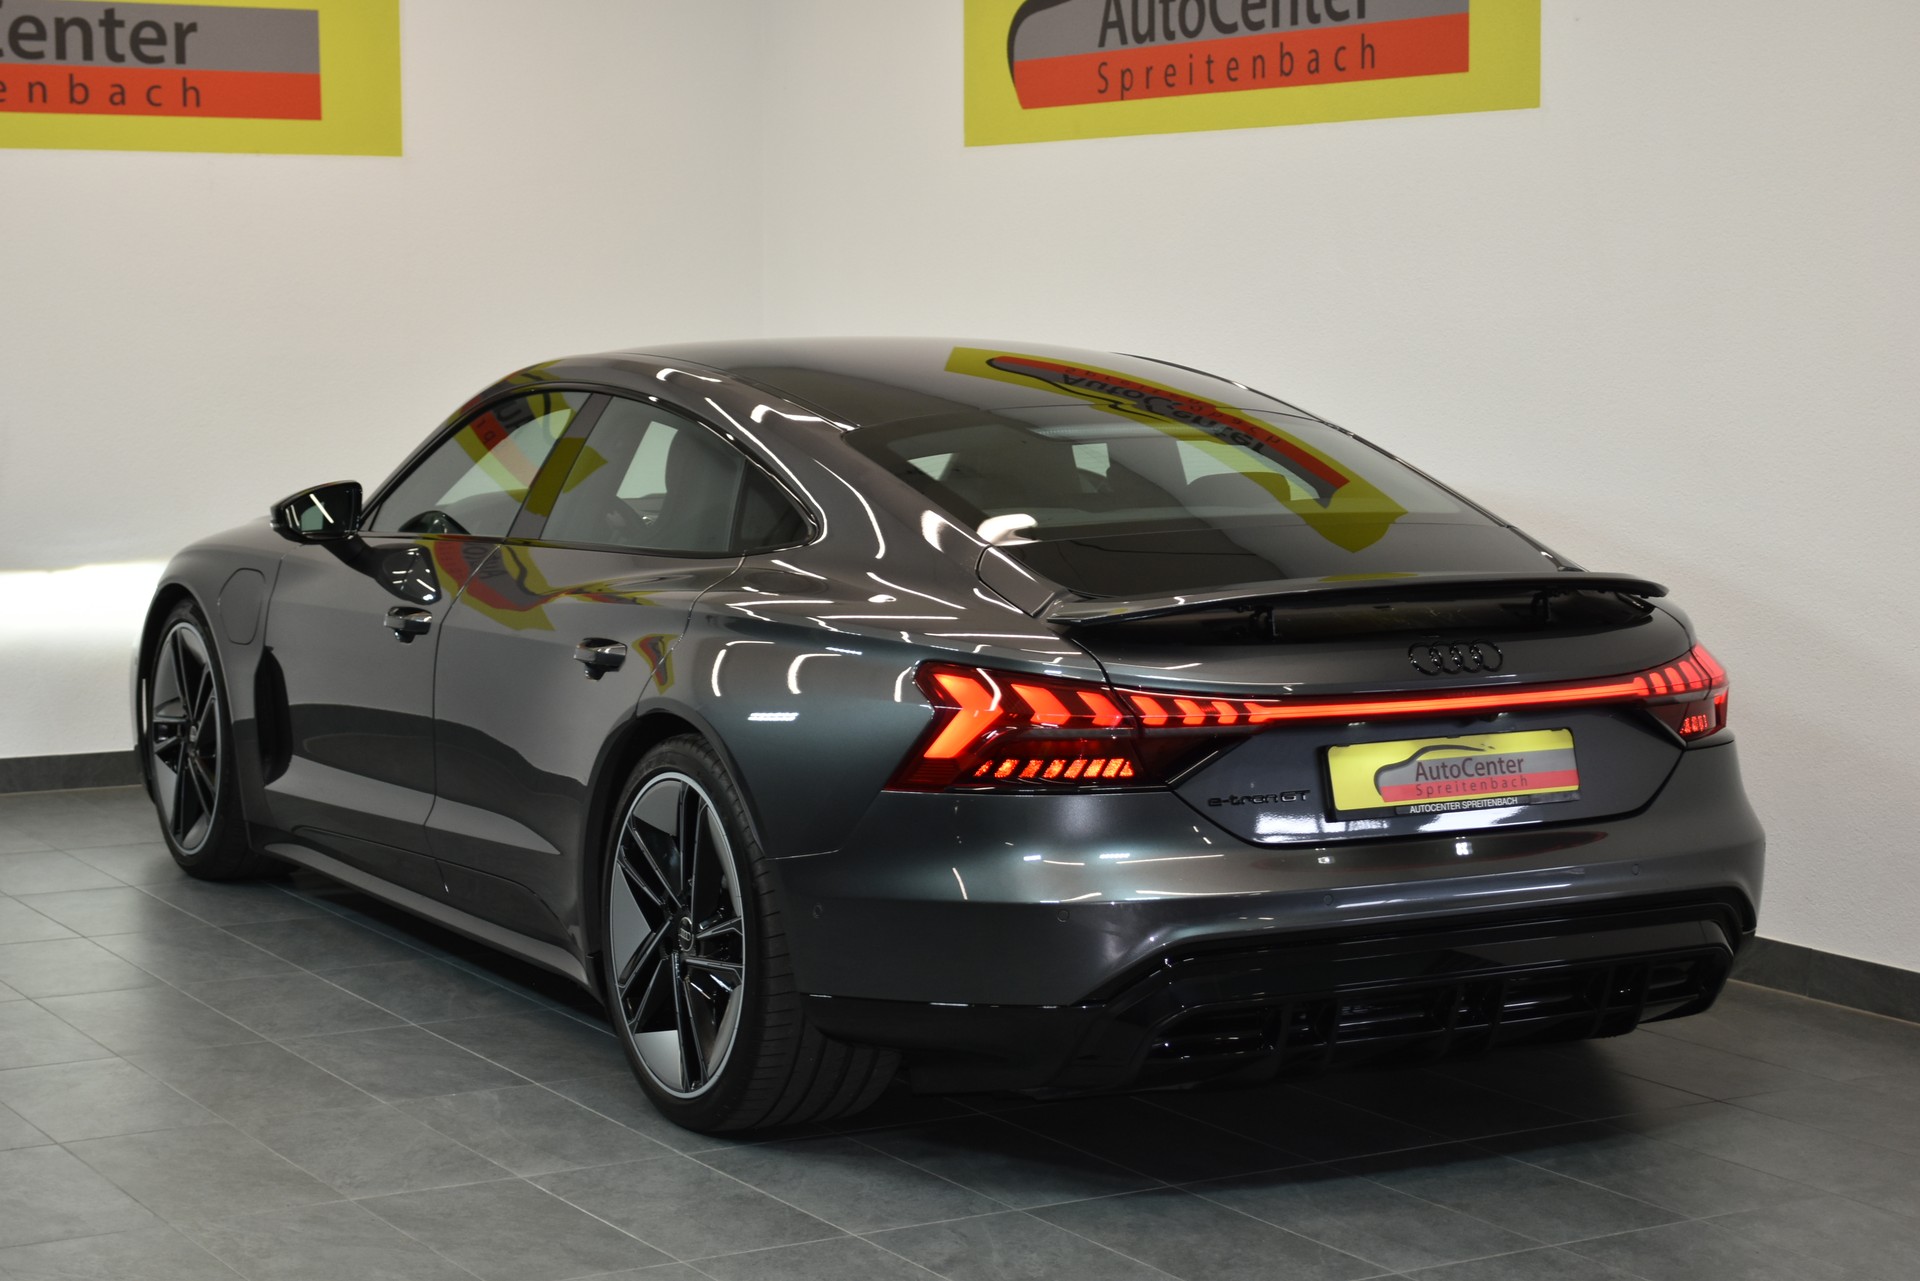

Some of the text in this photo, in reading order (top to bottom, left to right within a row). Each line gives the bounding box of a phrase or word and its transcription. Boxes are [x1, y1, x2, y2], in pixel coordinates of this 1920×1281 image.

[0, 0, 198, 65] enter
[1097, 33, 1376, 100] Spreitenbach
[1415, 757, 1525, 782] AutoCenter
[1415, 775, 1529, 798] Spreitenbach
[1409, 797, 1519, 814] AUTOCENTER SPREITENBACH
